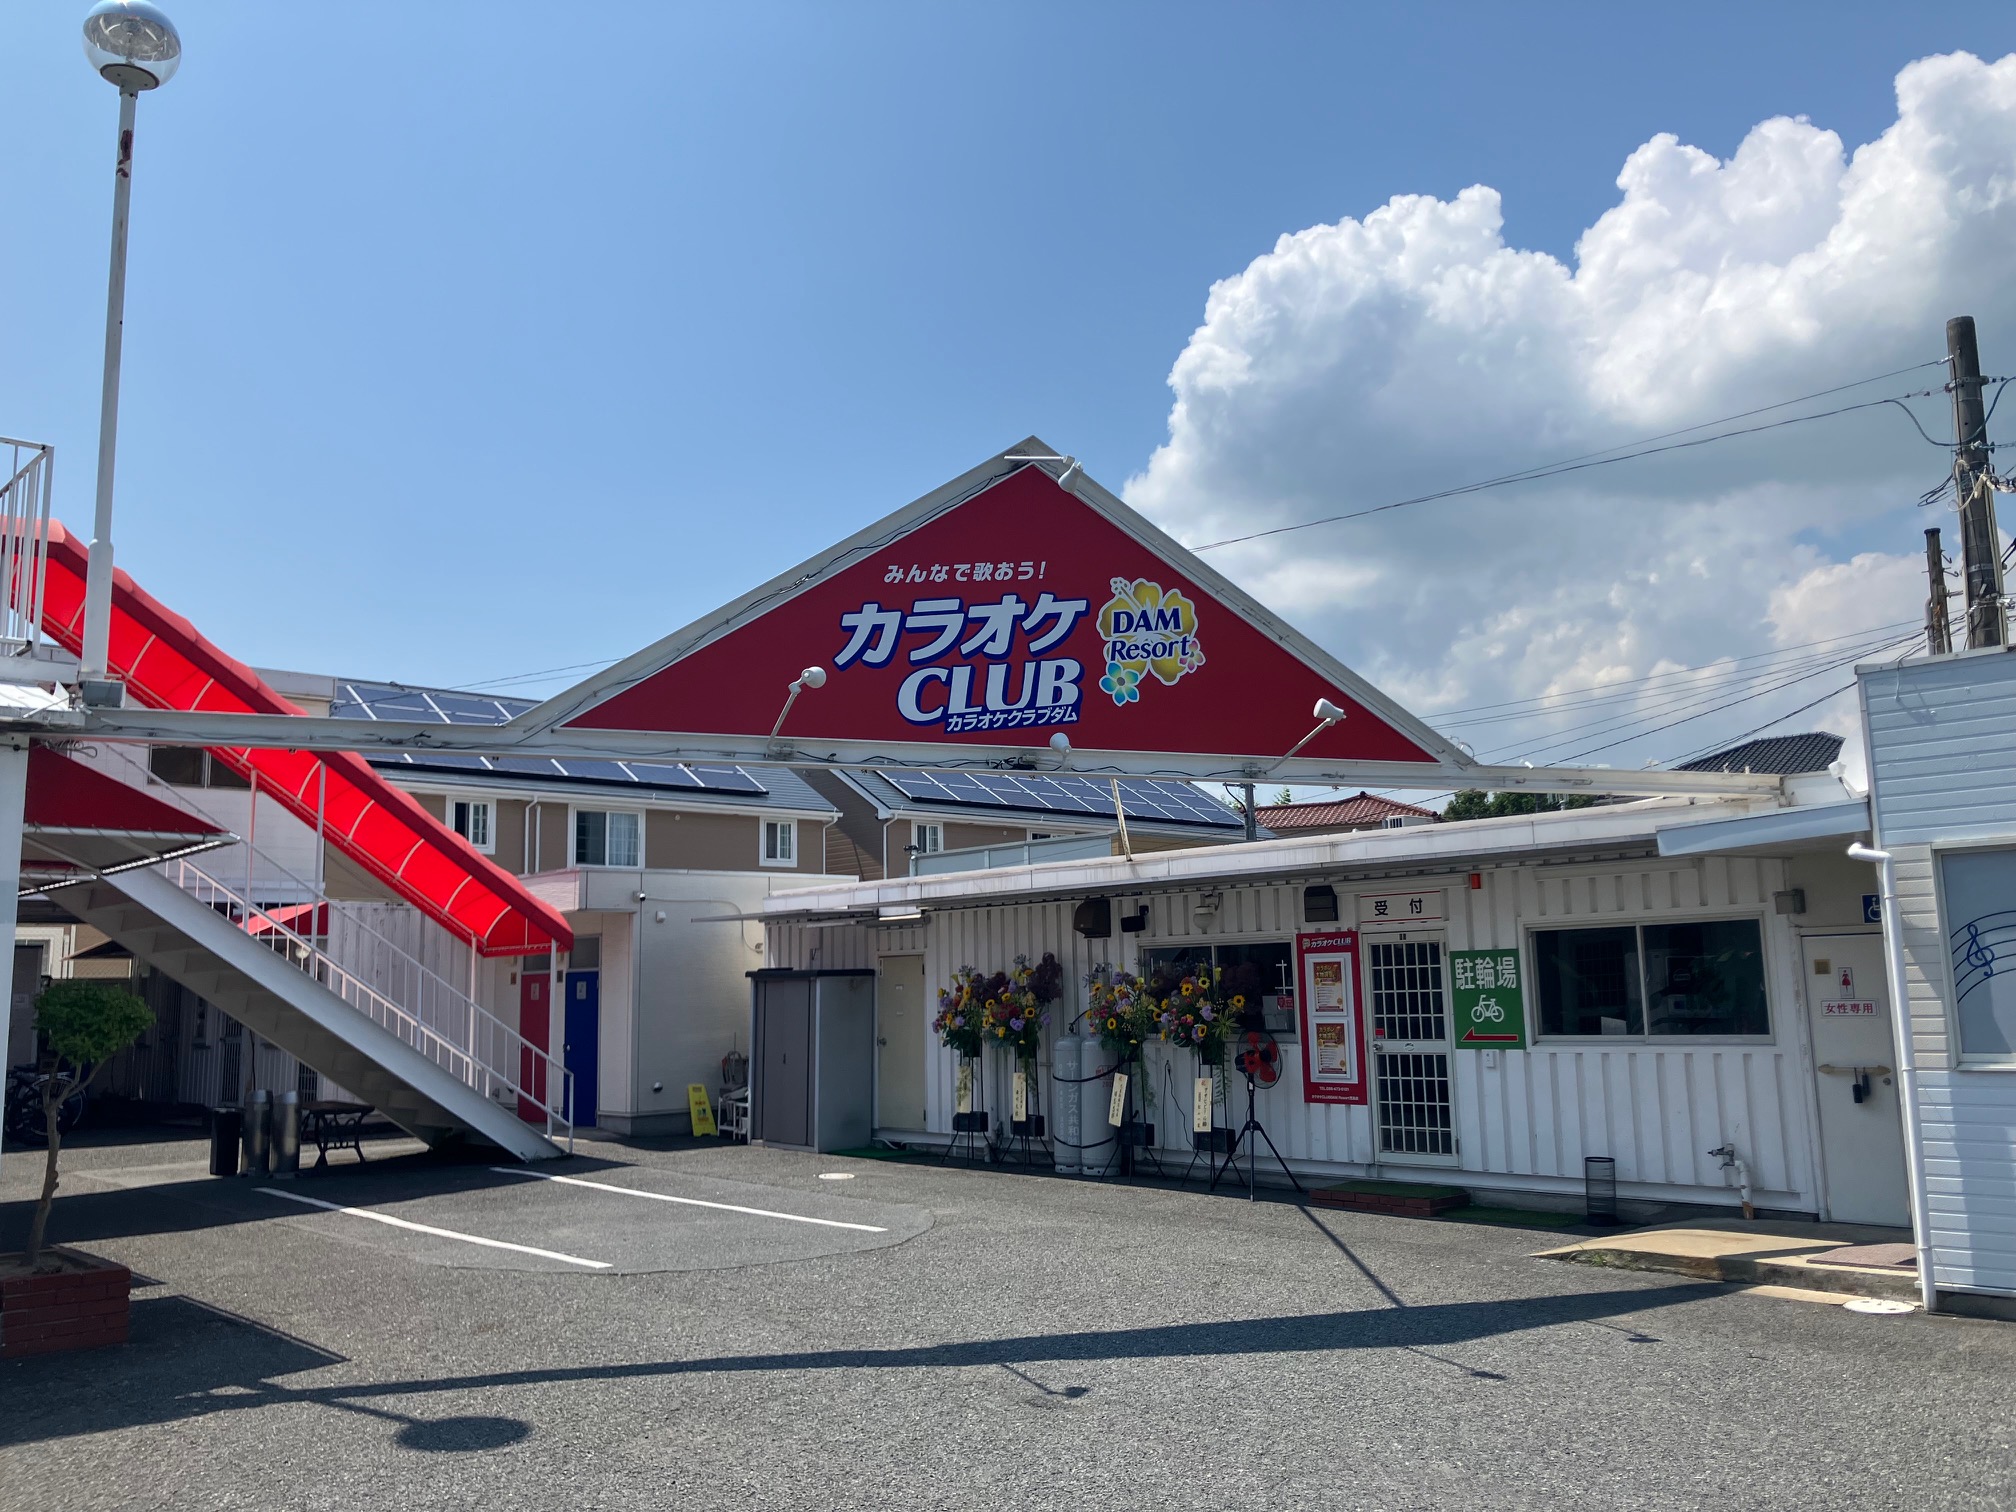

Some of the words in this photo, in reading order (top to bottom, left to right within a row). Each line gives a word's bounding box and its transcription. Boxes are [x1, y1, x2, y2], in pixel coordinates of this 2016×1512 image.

[833, 594, 1090, 670] カラオケ
[1112, 606, 1182, 635] DAM
[1110, 635, 1191, 662] Resort
[897, 658, 1083, 725] CLUB
[945, 706, 1079, 733] カラオケクラブダム
[1374, 897, 1423, 917] 受付
[1455, 956, 1518, 990] 駐輪場
[1824, 1002, 1874, 1015] 女性専用
